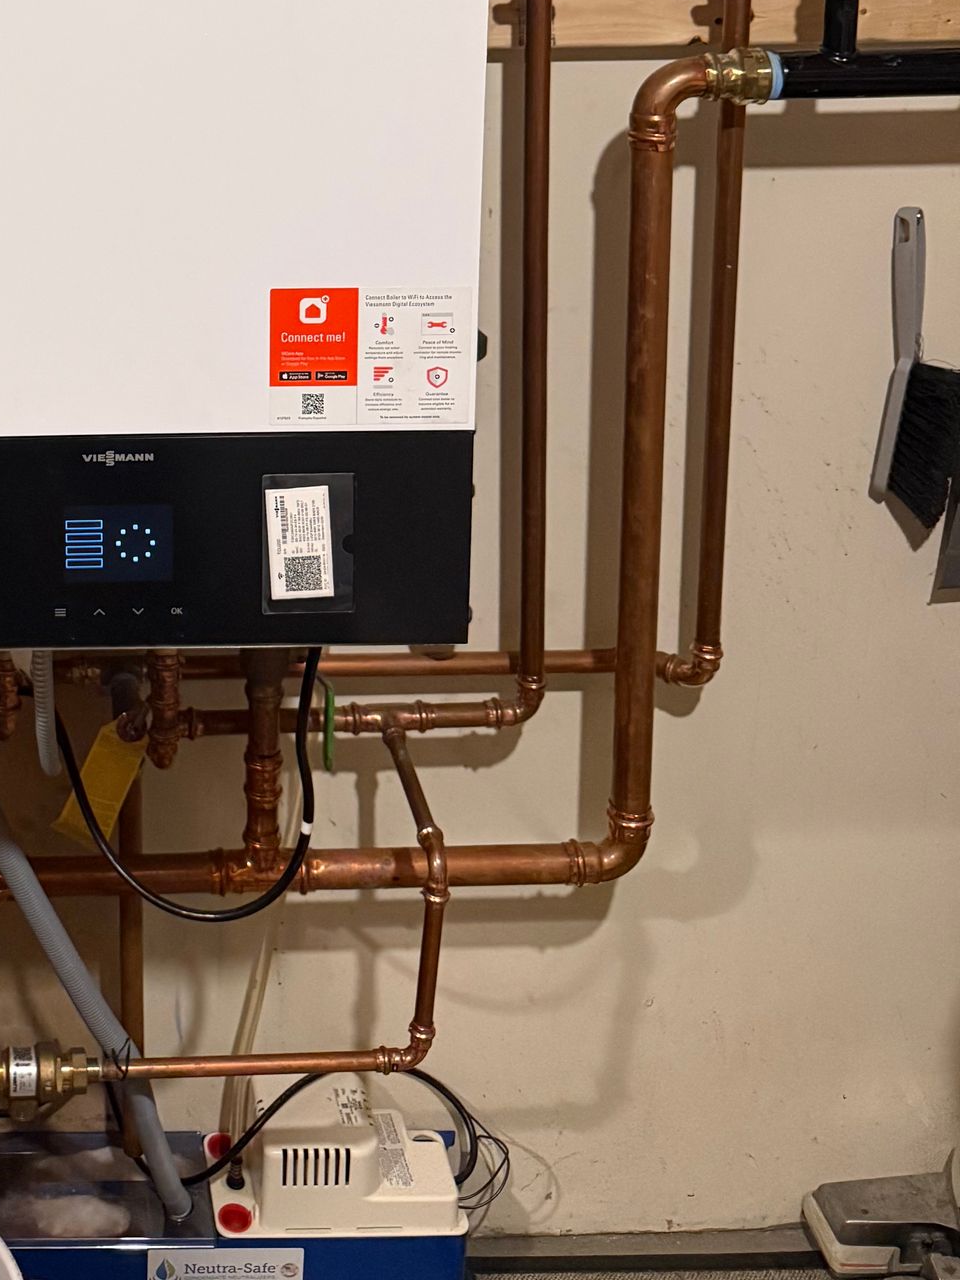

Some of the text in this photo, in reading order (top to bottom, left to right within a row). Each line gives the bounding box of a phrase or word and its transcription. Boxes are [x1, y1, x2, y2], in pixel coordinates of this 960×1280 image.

[281, 332, 346, 343] Connect me!
[82, 450, 154, 467] VIESSMANN
[170, 607, 183, 615] OK
